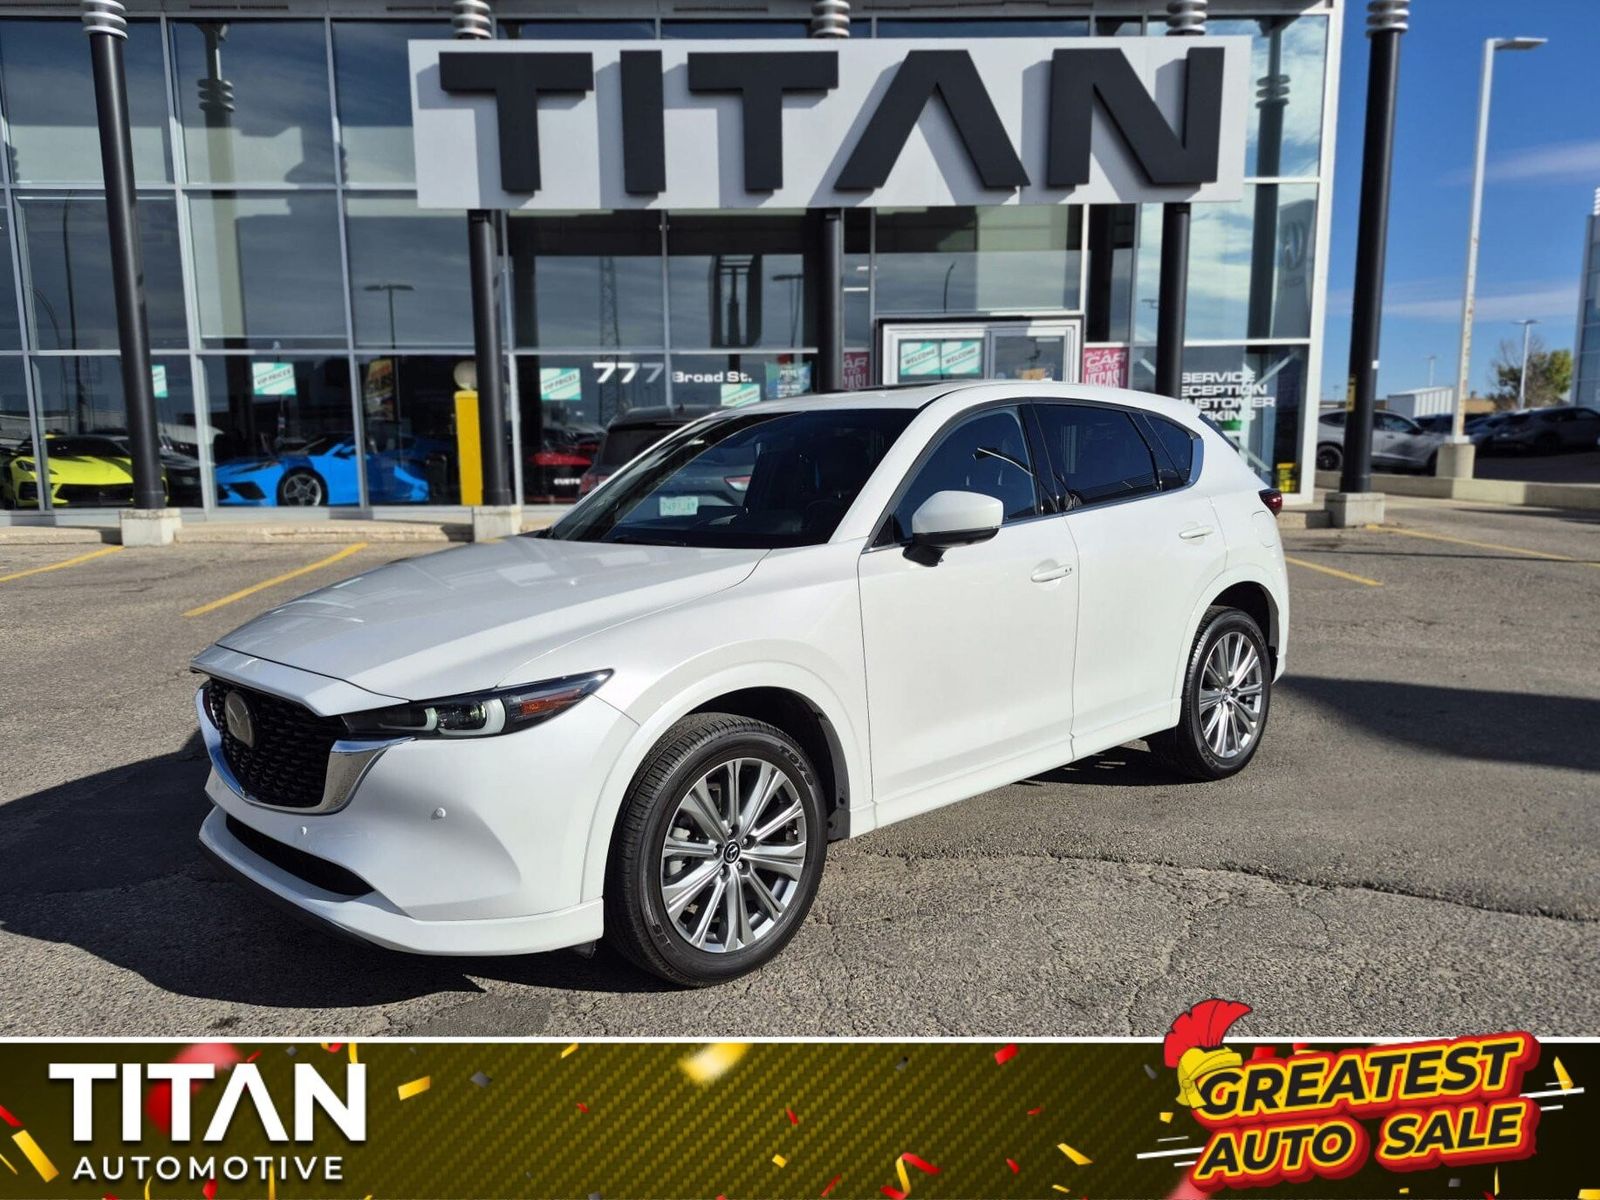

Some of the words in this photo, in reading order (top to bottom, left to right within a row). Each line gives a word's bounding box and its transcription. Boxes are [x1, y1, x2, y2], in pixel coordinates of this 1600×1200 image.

[439, 47, 1224, 193] TITAN
[945, 347, 976, 364] WELCOME
[1086, 353, 1126, 367] CAR
[593, 362, 664, 384] 777
[672, 371, 724, 383] Broad
[727, 371, 753, 383] St.
[1182, 371, 1256, 384] SERVICE
[1181, 384, 1268, 397] ECEPTION
[1183, 396, 1276, 409] USTOMER
